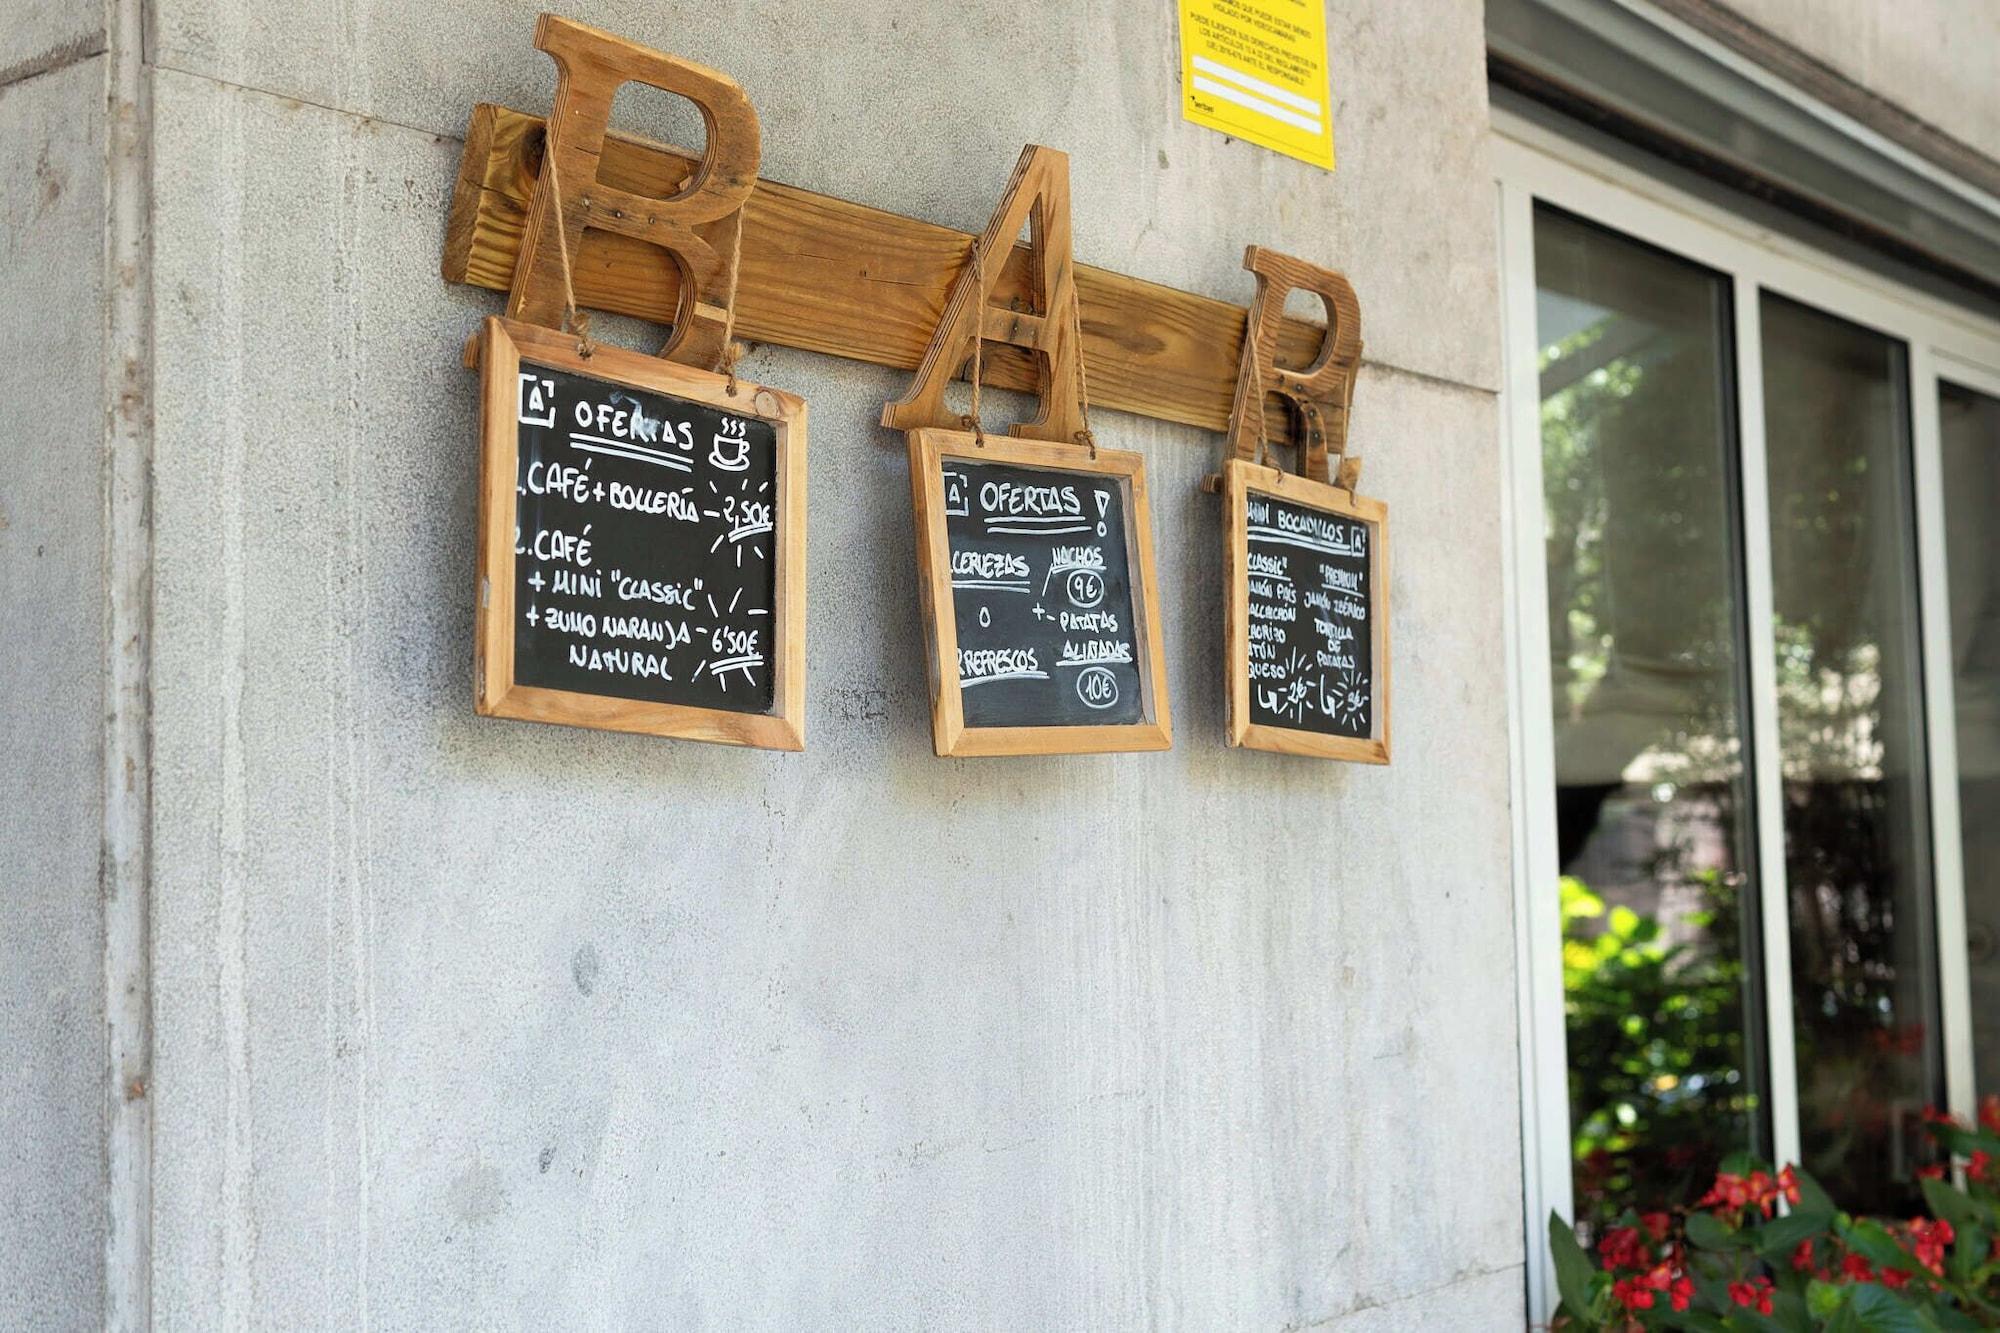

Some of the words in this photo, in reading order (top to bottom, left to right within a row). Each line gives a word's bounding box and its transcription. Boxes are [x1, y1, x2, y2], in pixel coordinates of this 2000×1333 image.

[979, 481, 1081, 515] OFERTAS
[1052, 545, 1104, 565] NACHOS
[545, 607, 596, 637] ZUMO
[602, 616, 691, 650] NARANJA
[1059, 611, 1118, 633] PATATAS
[1314, 618, 1354, 640] TORTILLA
[569, 644, 672, 681] NATURAL
[1317, 650, 1355, 668] PATATAS
